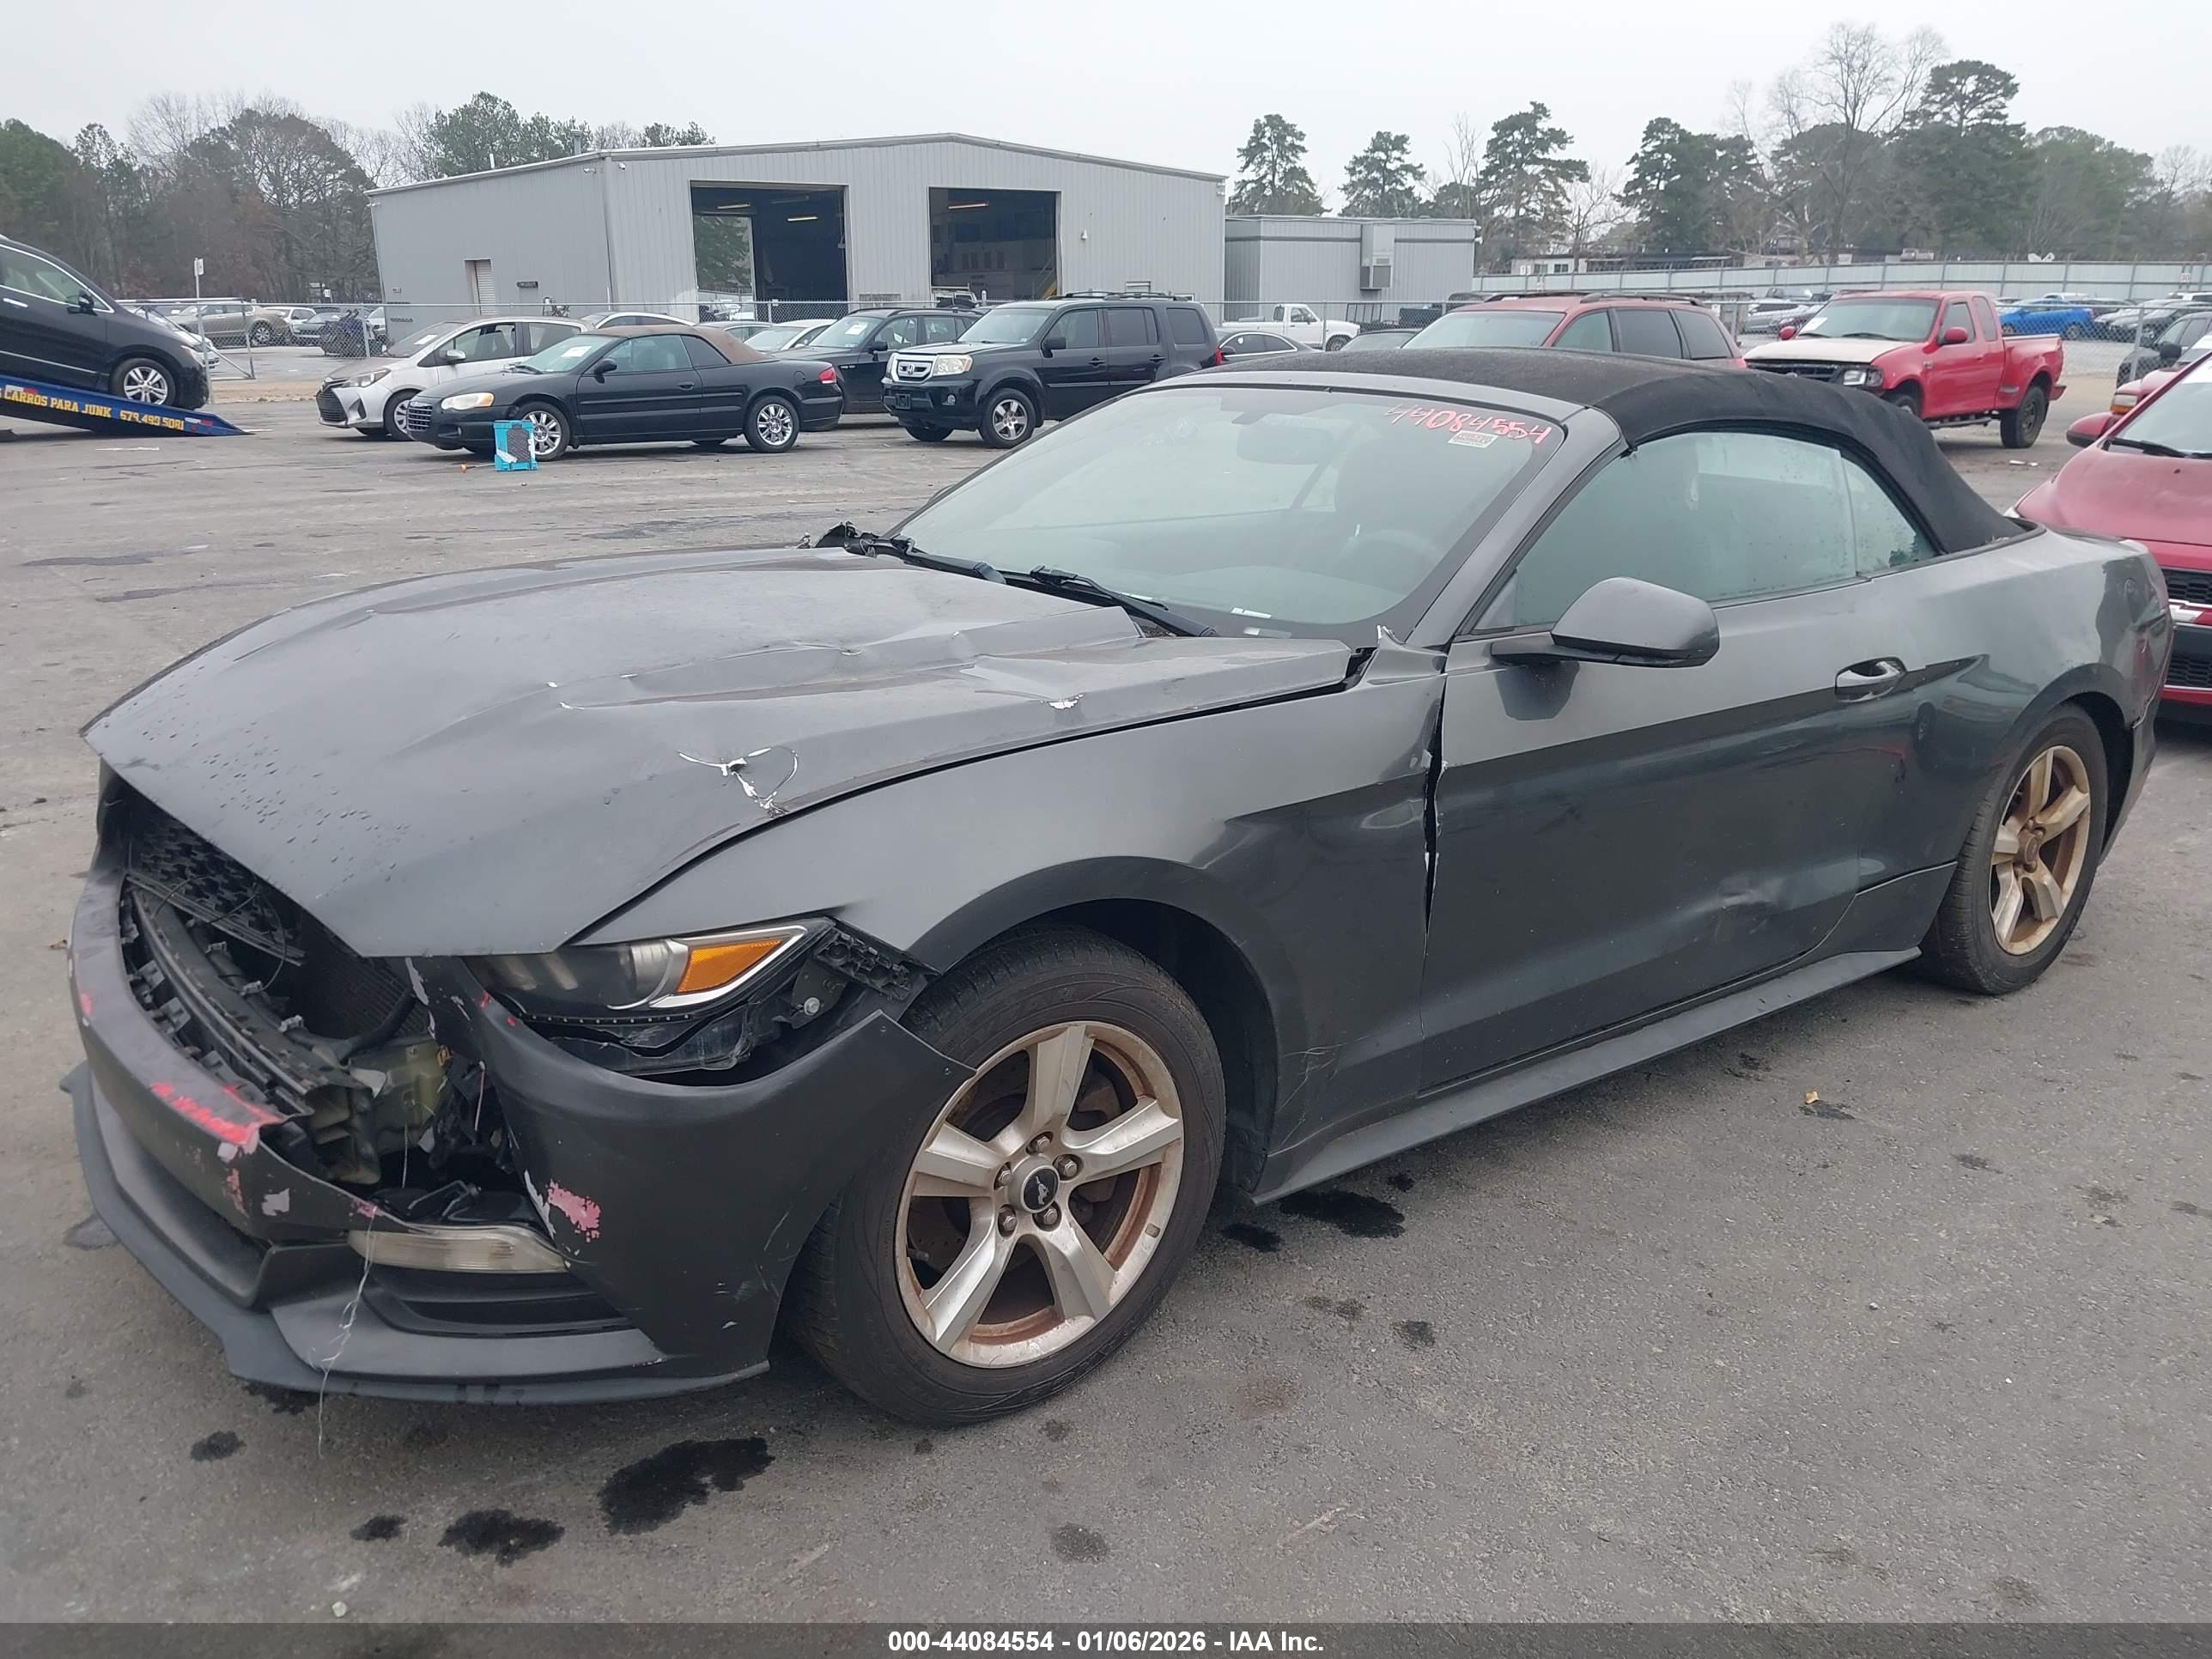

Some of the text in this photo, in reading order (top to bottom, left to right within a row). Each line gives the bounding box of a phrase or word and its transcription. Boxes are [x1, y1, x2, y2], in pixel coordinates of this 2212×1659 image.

[4, 390, 48, 406] CARROS
[50, 398, 78, 412] PARA
[82, 404, 112, 417] JUNK
[1385, 404, 1553, 445] 44084554
